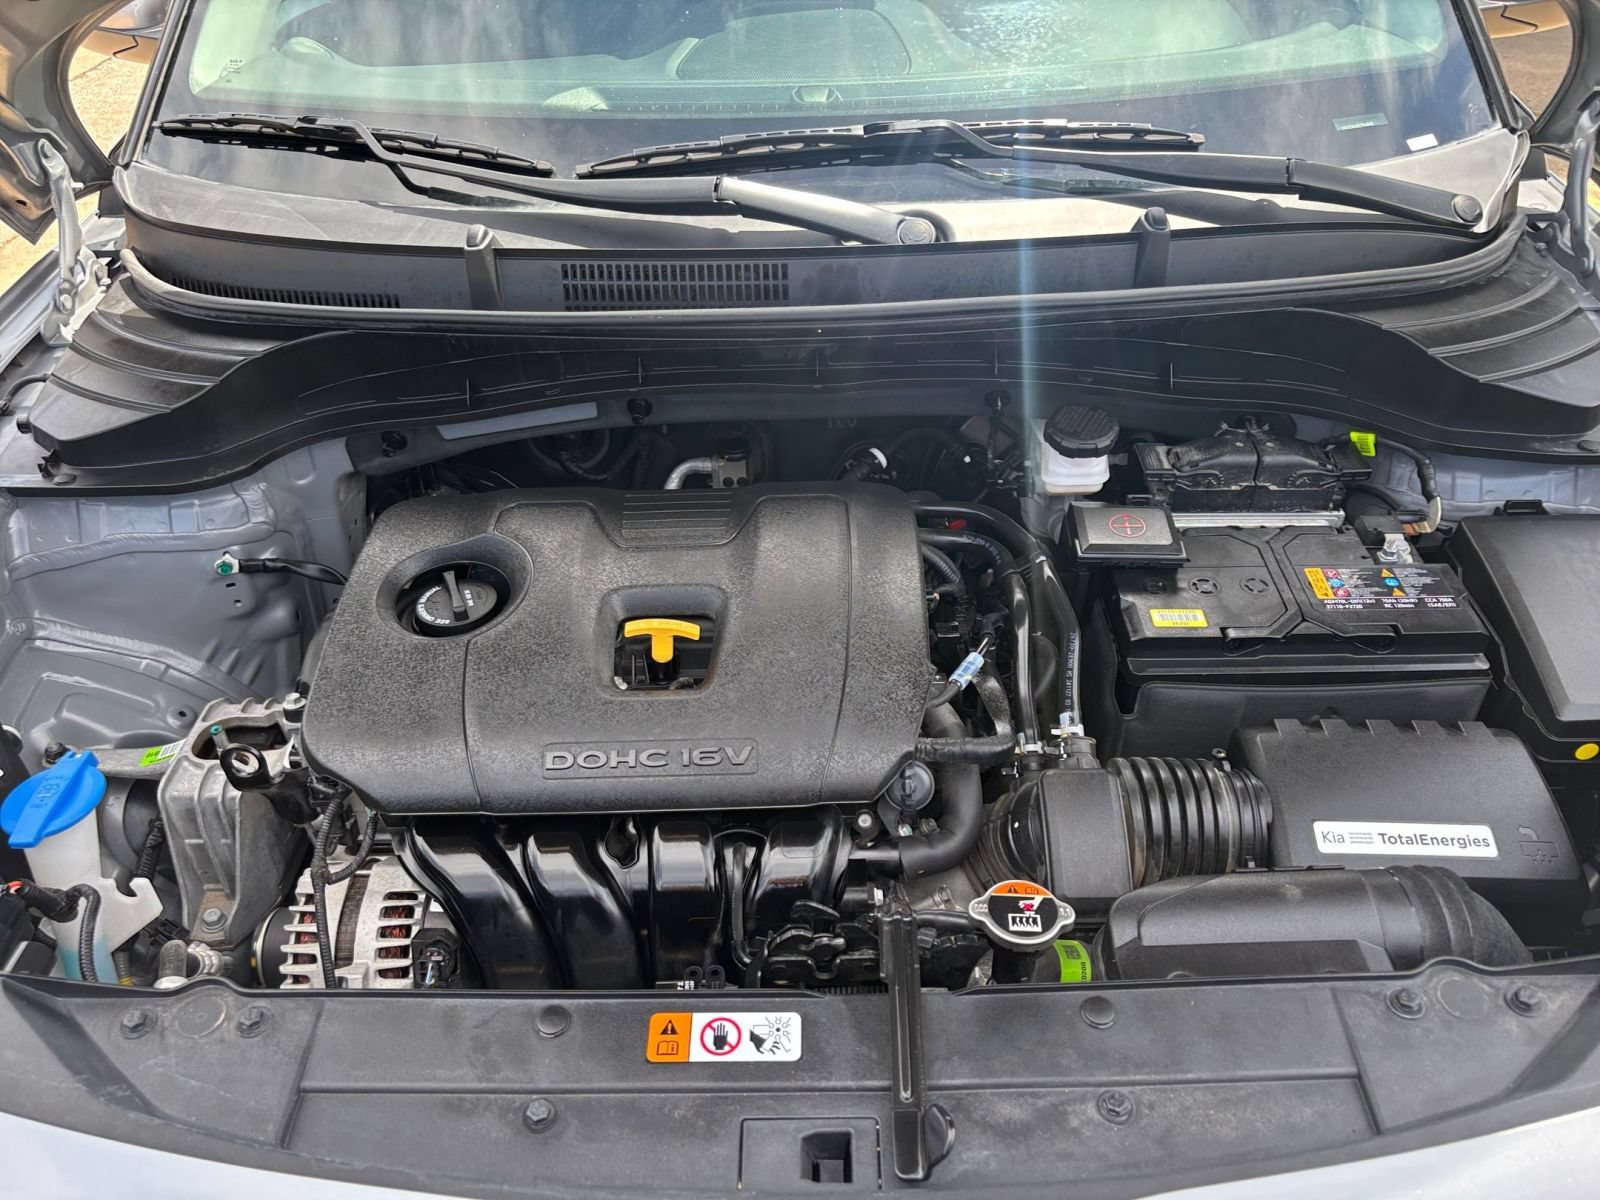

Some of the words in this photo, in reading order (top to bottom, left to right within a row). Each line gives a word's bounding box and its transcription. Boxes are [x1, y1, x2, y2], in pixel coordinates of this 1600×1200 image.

[545, 749, 669, 771] DOHC
[681, 746, 754, 767] 16V
[1321, 830, 1346, 844] Kia
[1377, 832, 1491, 849] TotalEnergies
[1059, 907, 1072, 917] 1.1
